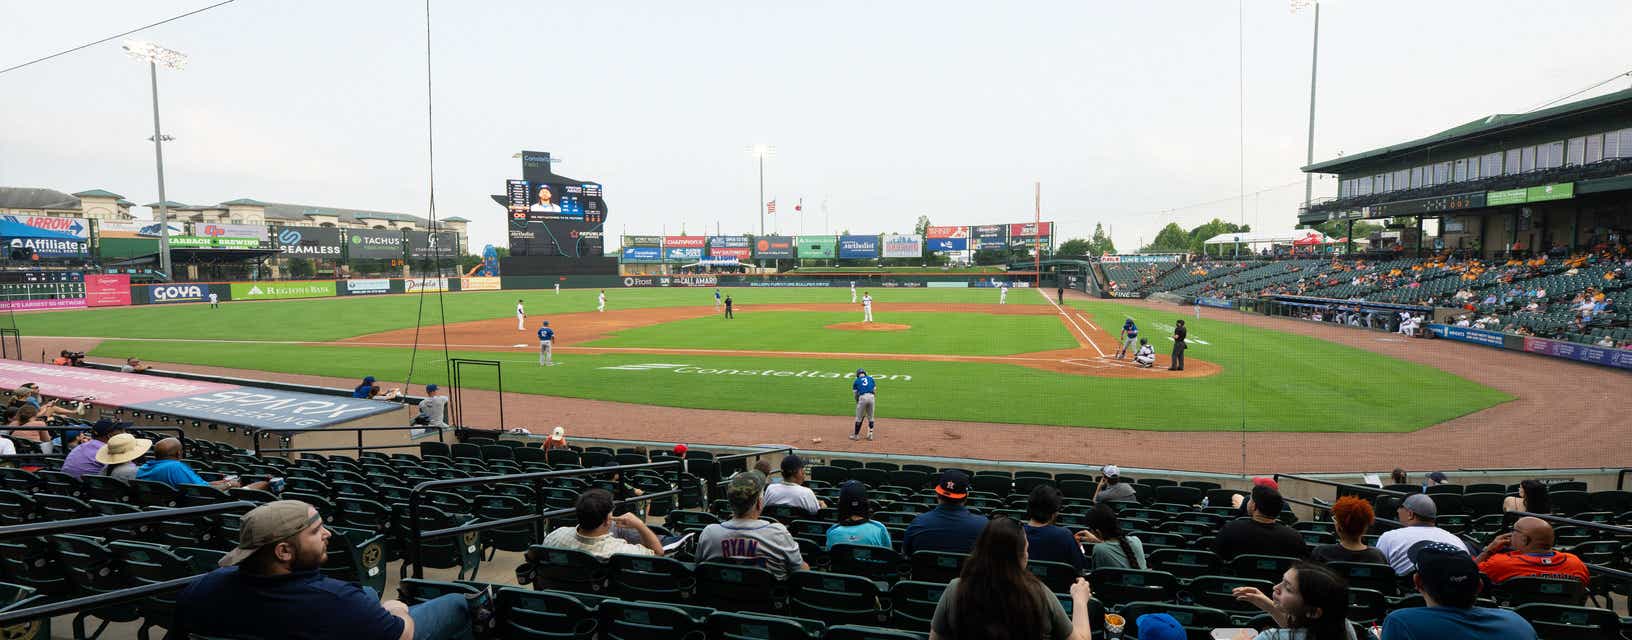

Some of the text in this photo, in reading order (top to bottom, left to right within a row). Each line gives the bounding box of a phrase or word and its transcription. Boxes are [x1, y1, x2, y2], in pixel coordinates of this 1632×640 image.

[27, 217, 72, 230] ARROW
[364, 236, 400, 245] TACHUS
[280, 246, 341, 254] SEAMLESS
[634, 277, 652, 285] Frost
[154, 285, 202, 300] GOYA
[673, 366, 913, 381] Constellaton
[861, 377, 868, 386] 3
[190, 391, 377, 419] SPARK
[720, 538, 758, 559] RYAN
